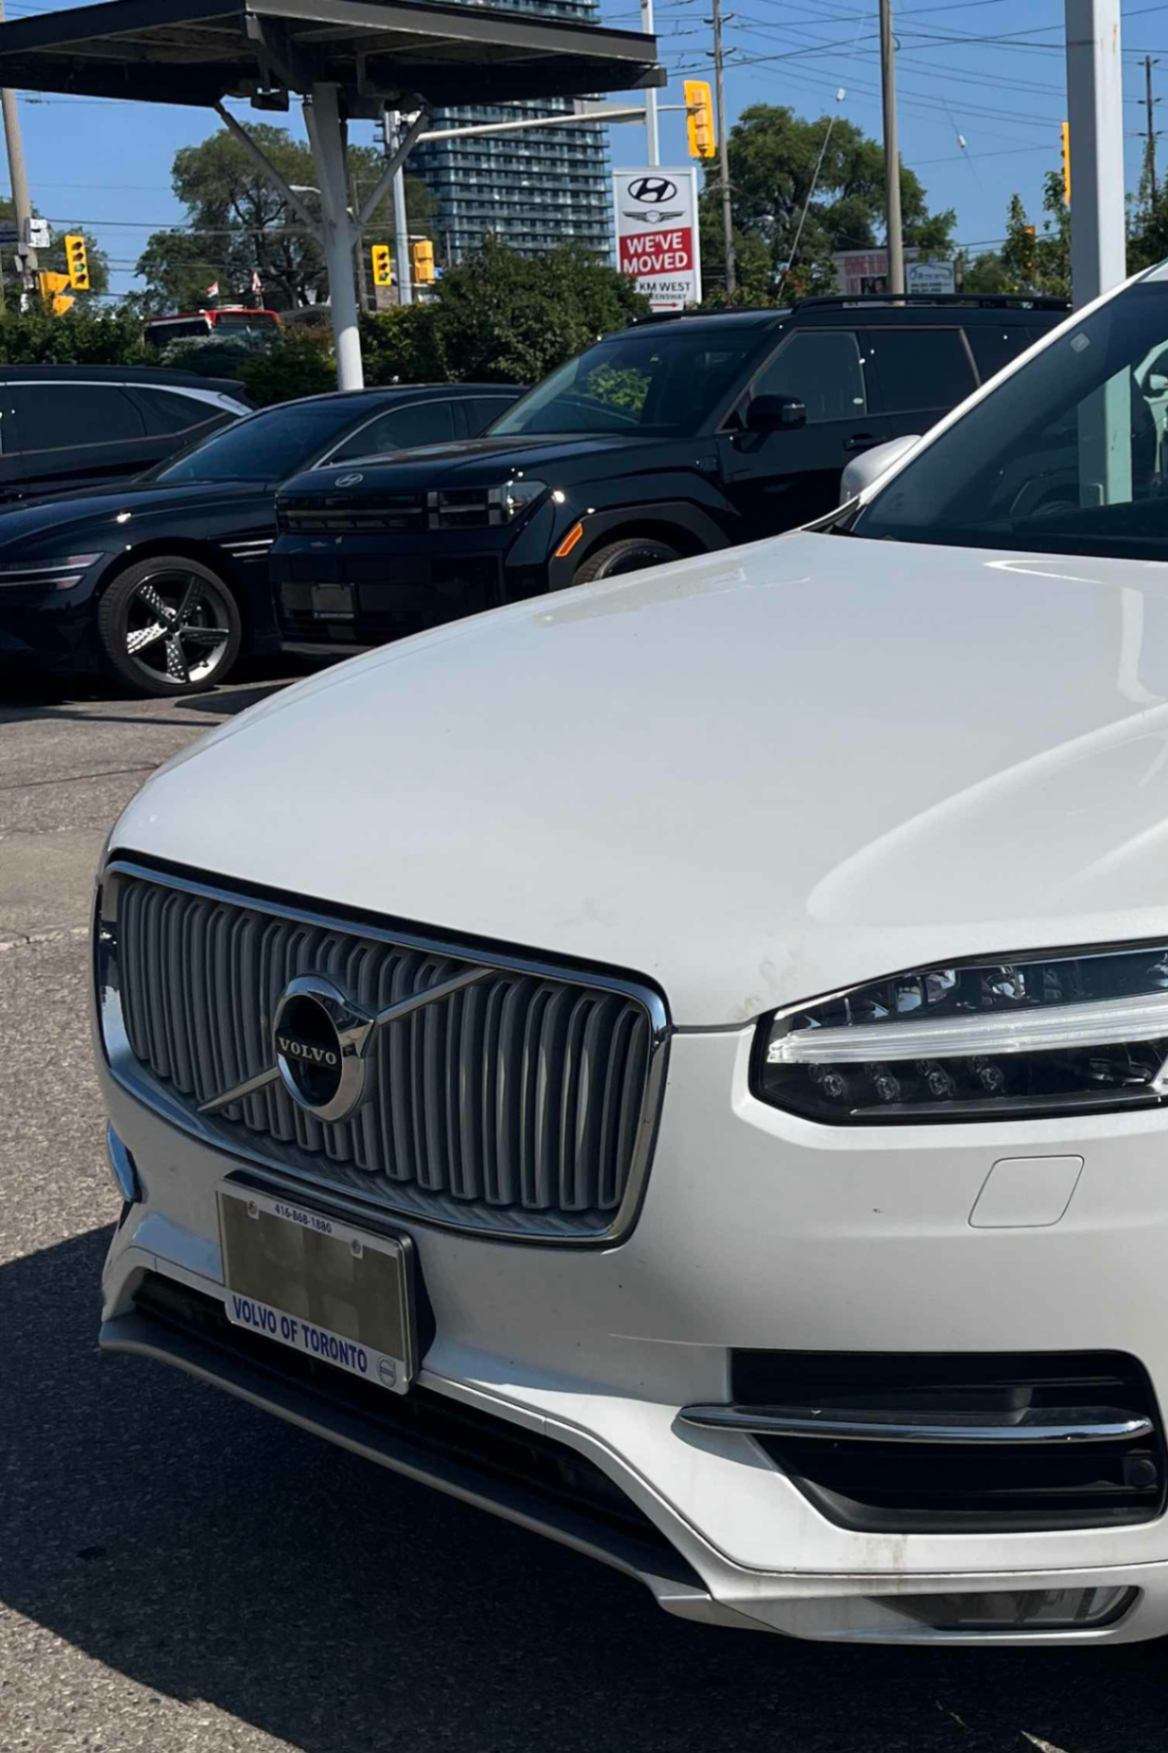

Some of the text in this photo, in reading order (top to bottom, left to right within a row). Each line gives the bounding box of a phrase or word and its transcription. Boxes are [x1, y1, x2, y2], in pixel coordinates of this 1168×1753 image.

[627, 232, 683, 254] WE'VE
[623, 252, 688, 273] MOVED
[640, 281, 690, 291] KM WEST
[279, 1037, 337, 1065] VOLVO
[232, 1295, 368, 1373] VOLVO OF TORONTO
